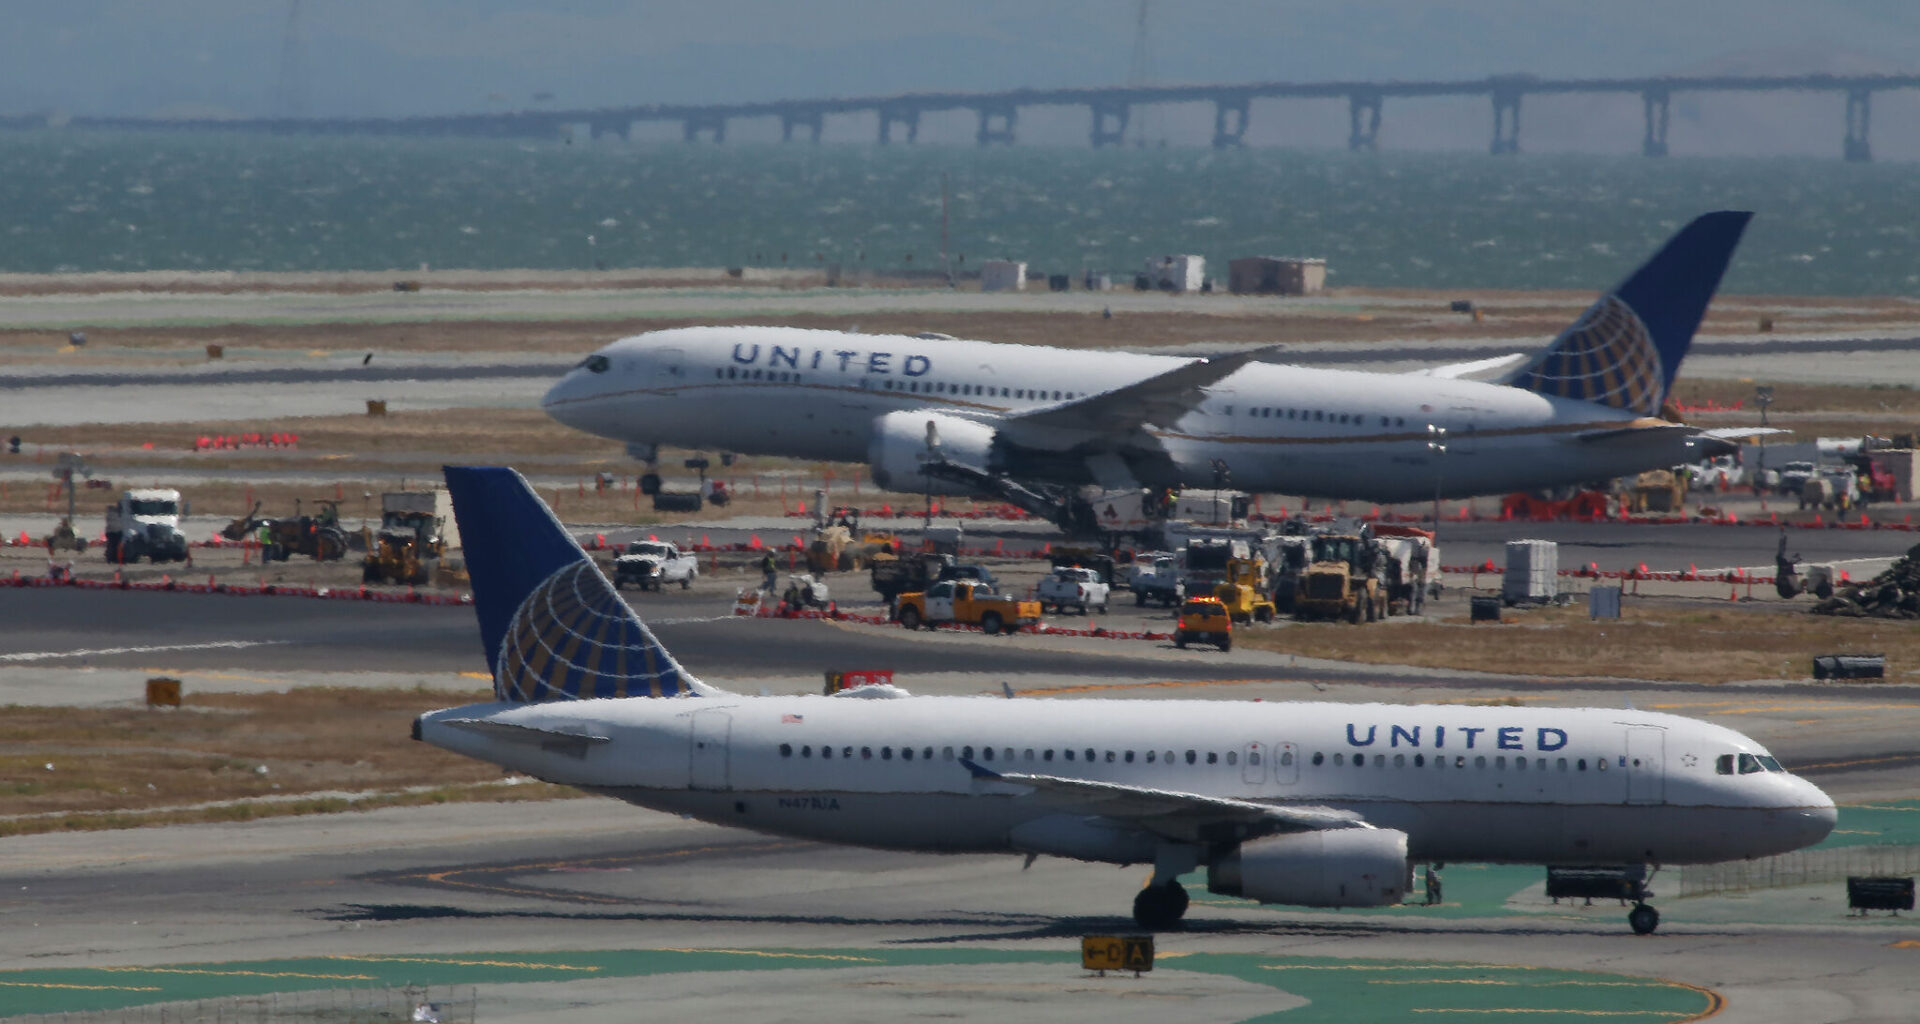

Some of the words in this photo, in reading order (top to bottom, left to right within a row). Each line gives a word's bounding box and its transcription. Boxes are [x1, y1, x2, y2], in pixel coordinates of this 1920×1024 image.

[733, 344, 930, 376] UNITED
[1346, 723, 1568, 751] UNITED
[1107, 943, 1121, 962] D
[1130, 943, 1145, 964] A
